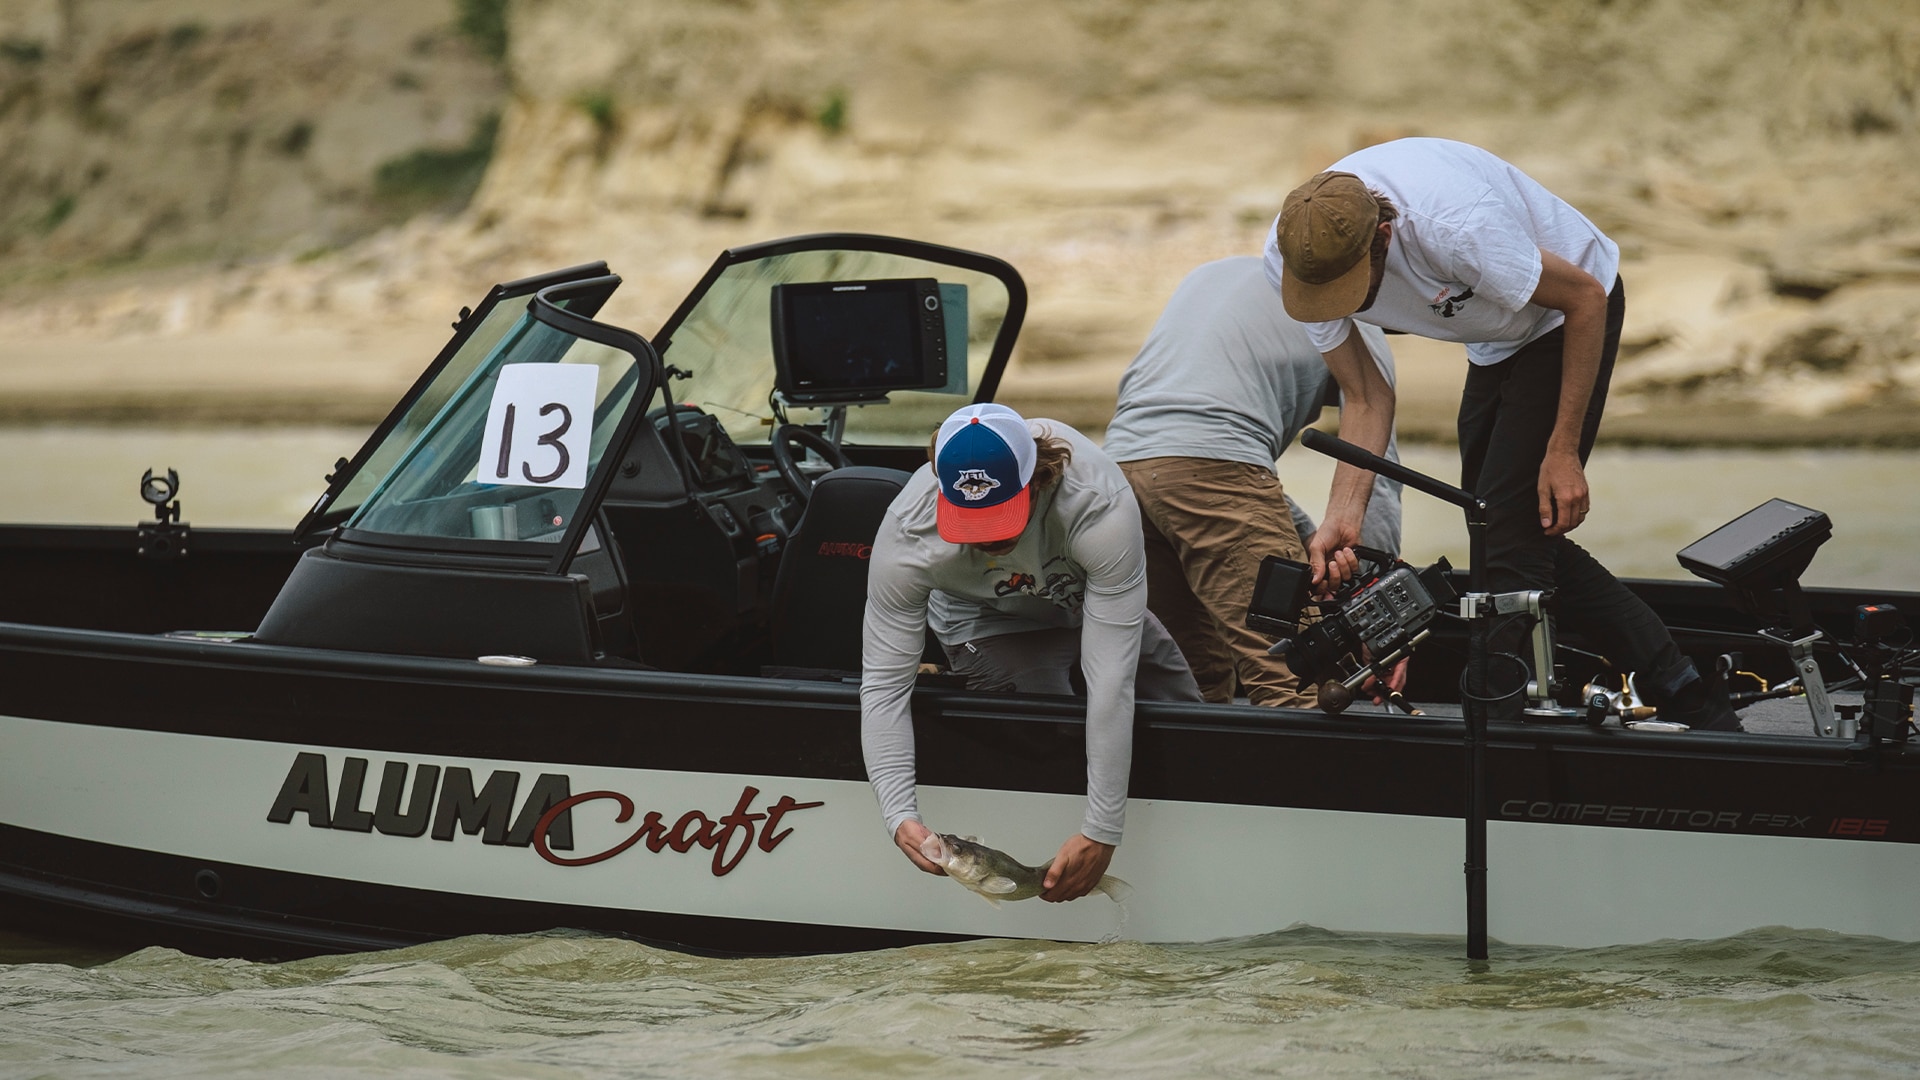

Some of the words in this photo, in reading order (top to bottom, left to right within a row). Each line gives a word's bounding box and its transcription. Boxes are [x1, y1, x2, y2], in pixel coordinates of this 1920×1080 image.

[496, 402, 572, 484] 13
[961, 471, 985, 480] YETI
[1379, 572, 1399, 588] SONY
[1500, 799, 1742, 829] COMPETITOR
[1748, 812, 1812, 829] FSX
[1828, 817, 1890, 836] 185
